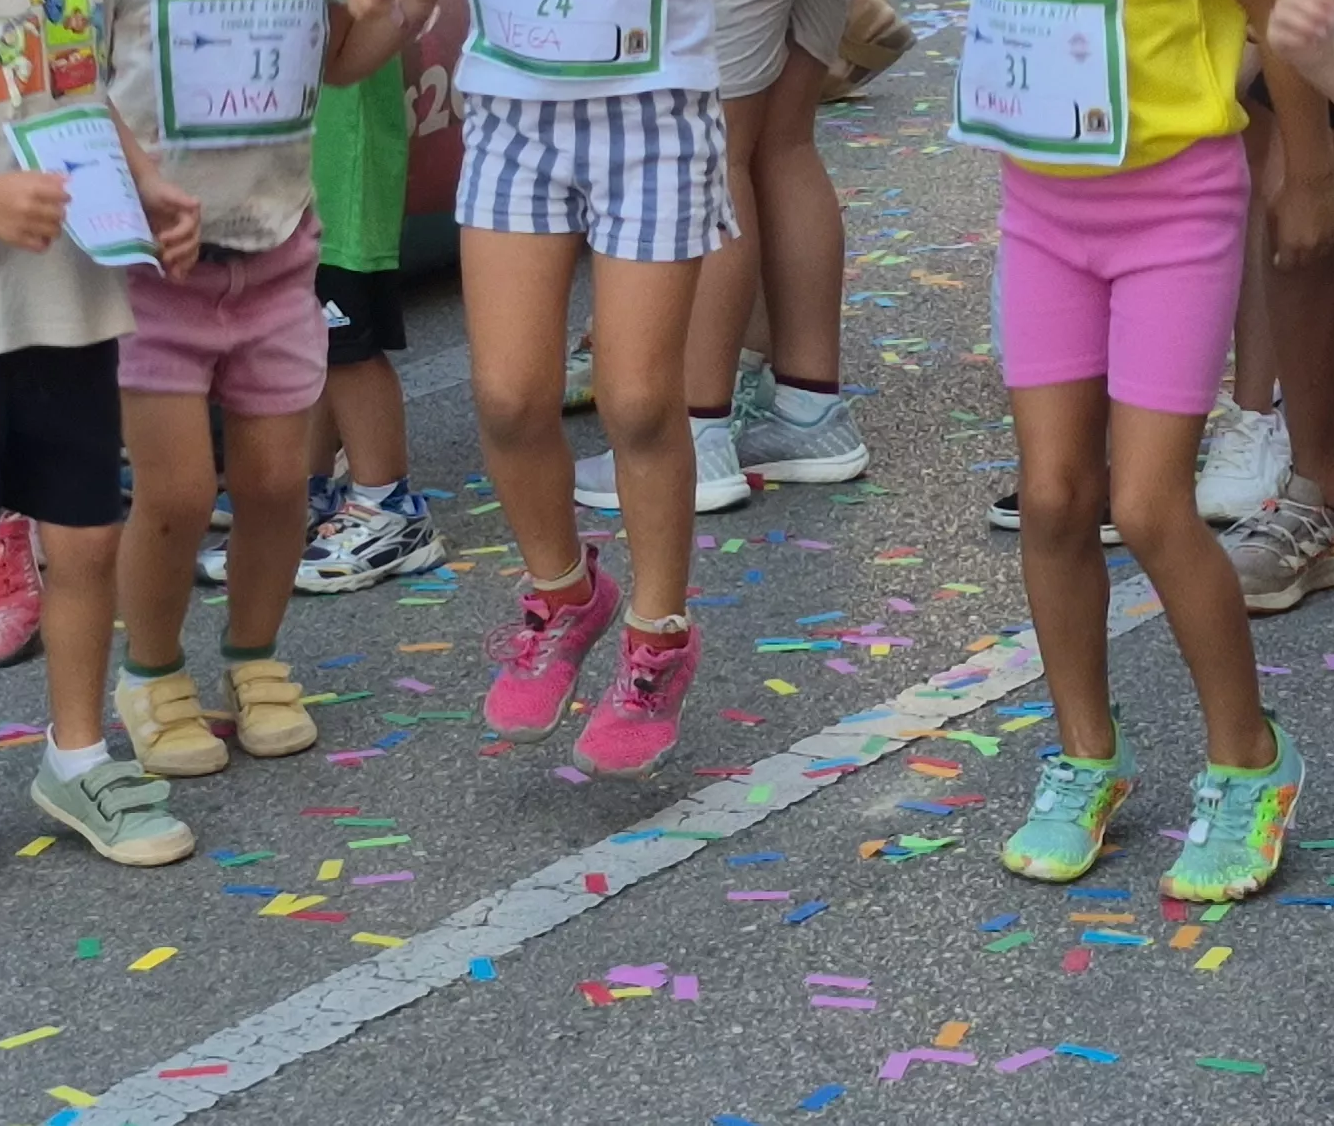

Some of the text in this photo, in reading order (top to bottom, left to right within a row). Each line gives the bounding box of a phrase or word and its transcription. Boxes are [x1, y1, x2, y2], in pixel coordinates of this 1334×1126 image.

[497, 10, 562, 52] VEGA
[251, 47, 280, 81] 13
[1005, 54, 1030, 91] 31
